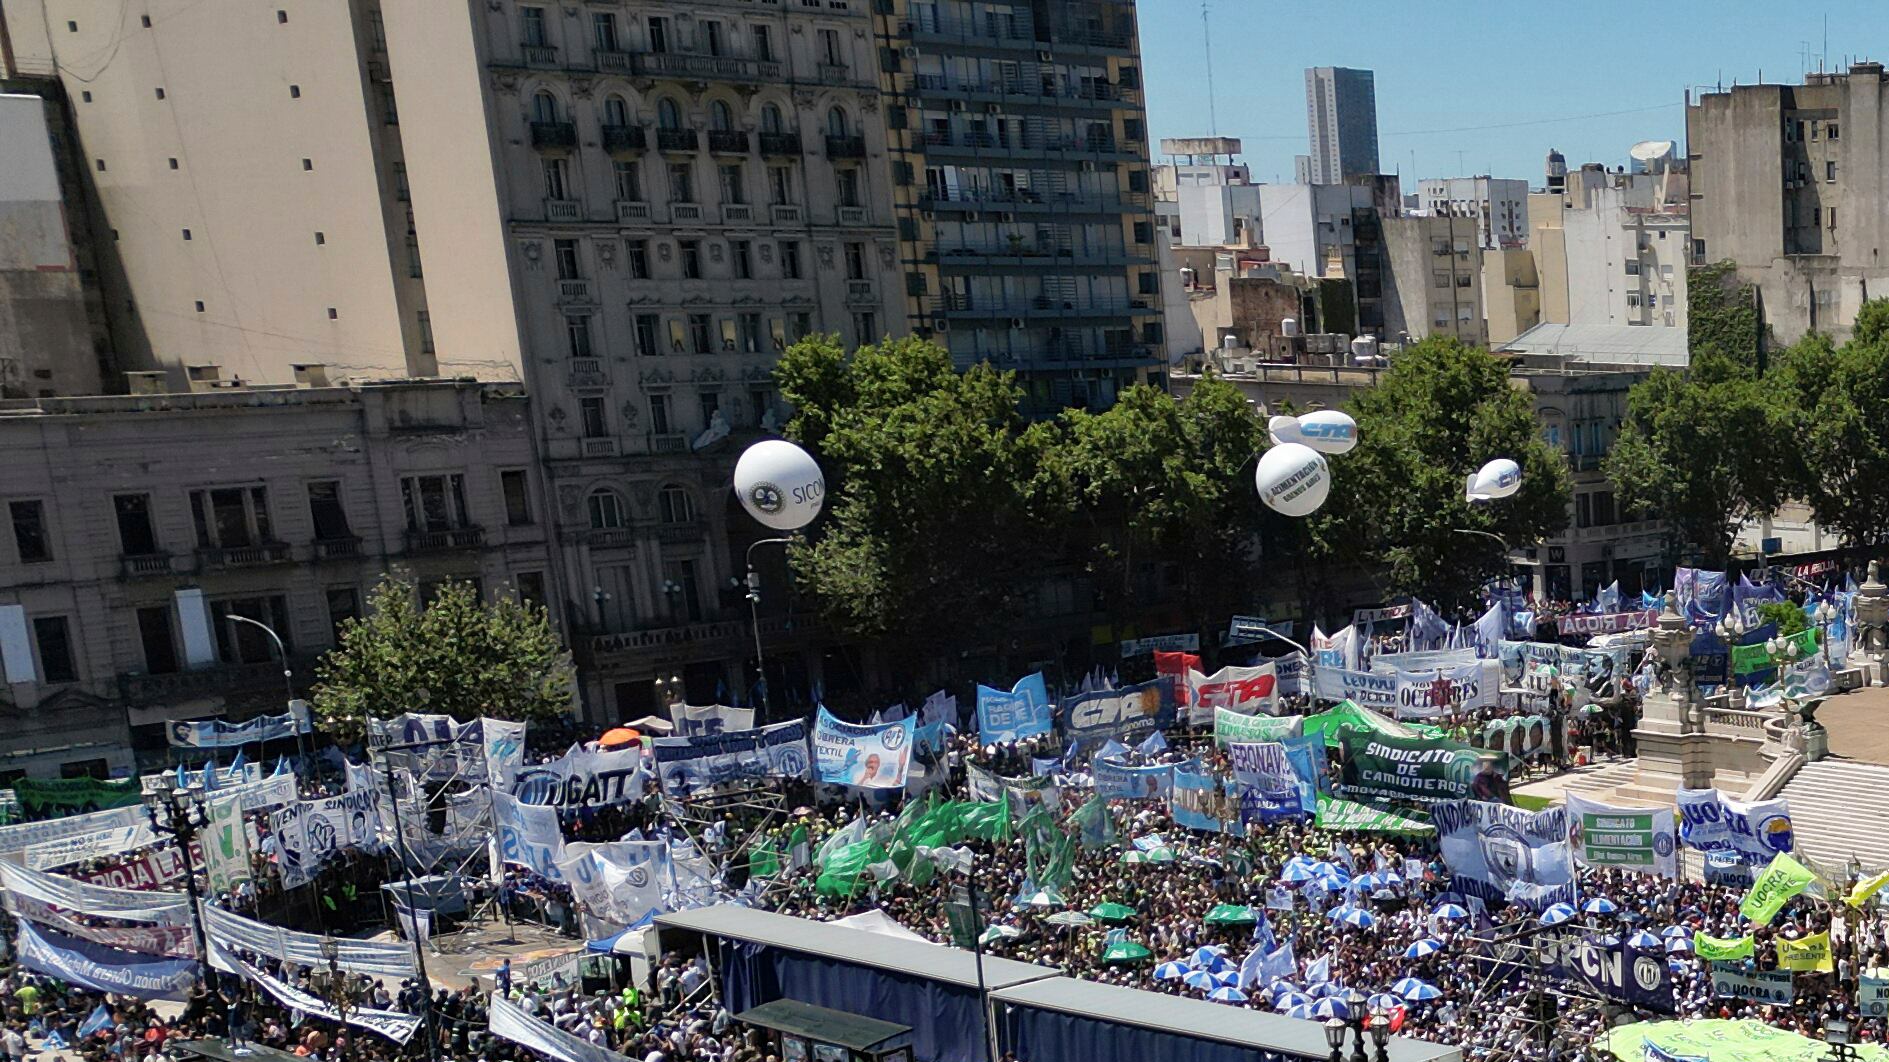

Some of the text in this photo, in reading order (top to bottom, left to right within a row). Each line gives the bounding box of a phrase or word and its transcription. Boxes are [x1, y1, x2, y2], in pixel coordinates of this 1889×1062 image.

[817, 732, 855, 746] OBRERA
[1365, 742, 1455, 763] SINDICATO
[1397, 763, 1418, 776] DE
[1362, 770, 1467, 795] CAMIONEROS
[1595, 817, 1635, 830] SINDICATO
[1591, 833, 1643, 847] ALIMENTACIÓN
[1751, 868, 1788, 909] UOCRA
[1539, 934, 1623, 988] UPCN
[1733, 983, 1771, 998] UOCRA
